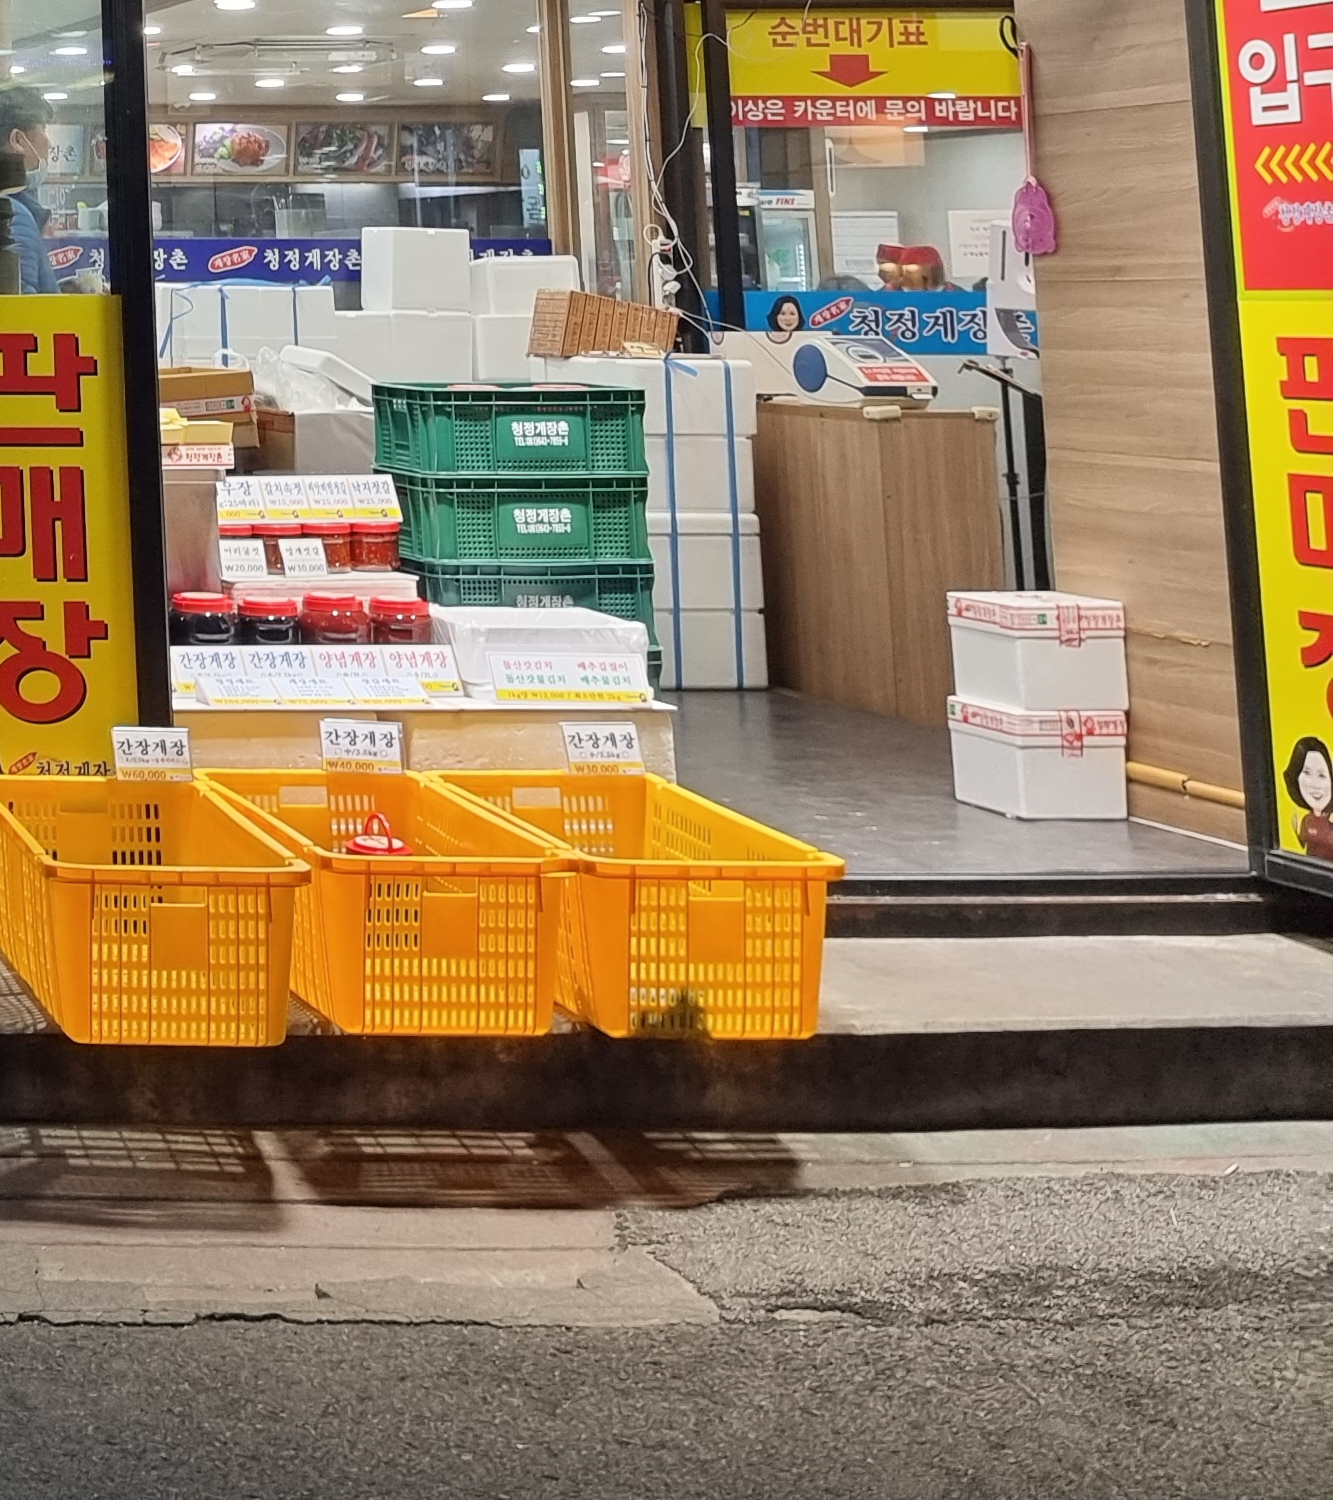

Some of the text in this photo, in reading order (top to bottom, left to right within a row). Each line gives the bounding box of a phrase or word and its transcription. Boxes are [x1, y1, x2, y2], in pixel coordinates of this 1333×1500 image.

[767, 15, 929, 49] 순번대기표
[731, 99, 1019, 121] 이상은 카운터에 문의 바랍니다
[263, 247, 362, 271] 청정게장촌
[510, 420, 570, 437] 청정게장촌
[513, 507, 572, 524] 청정게장촌
[178, 650, 237, 671] 간장게장
[248, 650, 307, 671] 간장게장
[318, 650, 378, 670] 양념게장
[388, 650, 448, 670] 양념게장
[116, 738, 187, 757] 간장게장
[324, 728, 396, 749] 간장게장
[567, 731, 635, 750] 간장게장
